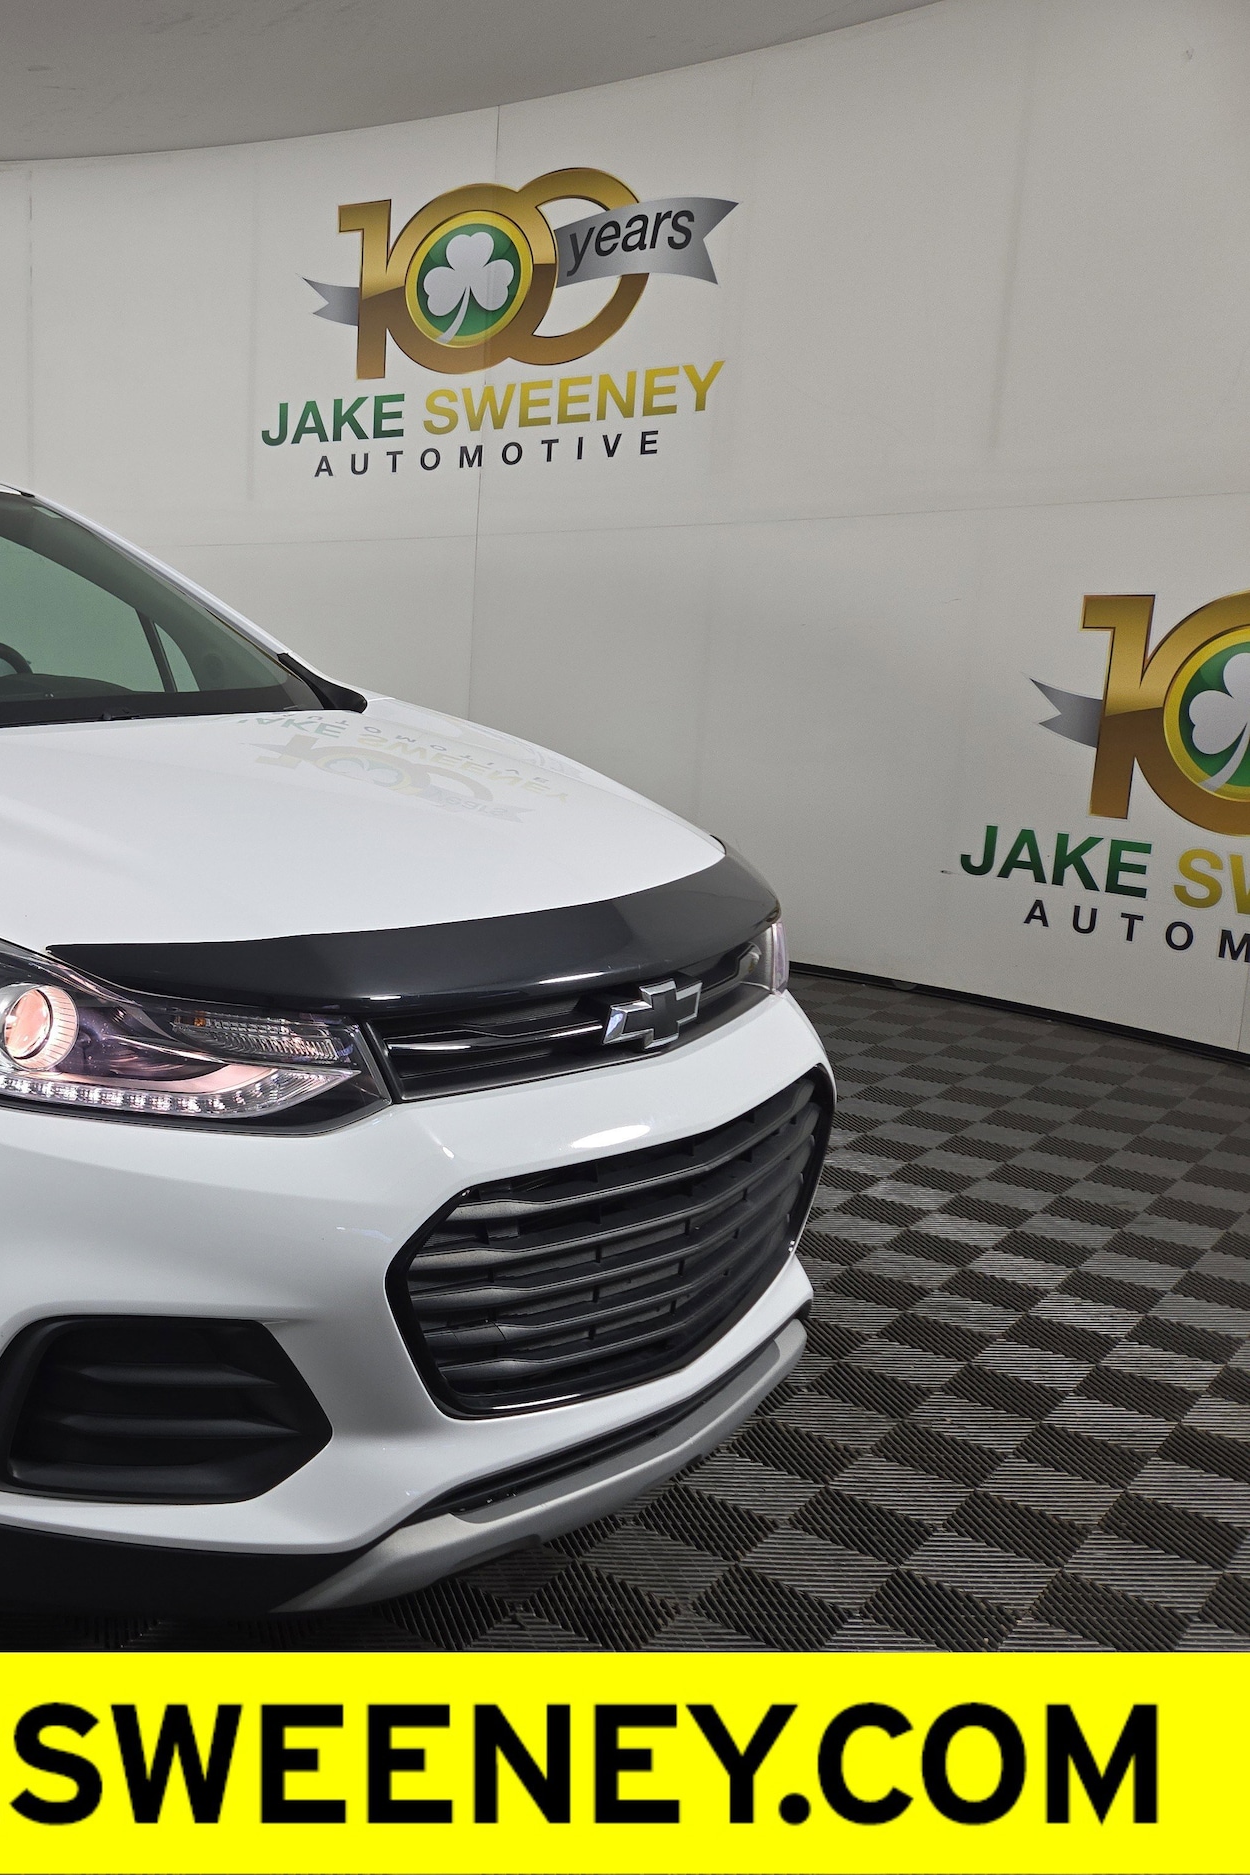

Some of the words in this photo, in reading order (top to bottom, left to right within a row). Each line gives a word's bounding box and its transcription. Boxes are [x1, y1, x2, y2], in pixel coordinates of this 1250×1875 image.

[566, 207, 696, 276] years
[261, 393, 405, 447] JAKE
[423, 360, 725, 436] SWEENEY
[314, 430, 659, 478] AUTOMOTIVE
[960, 825, 1152, 898] JAKE
